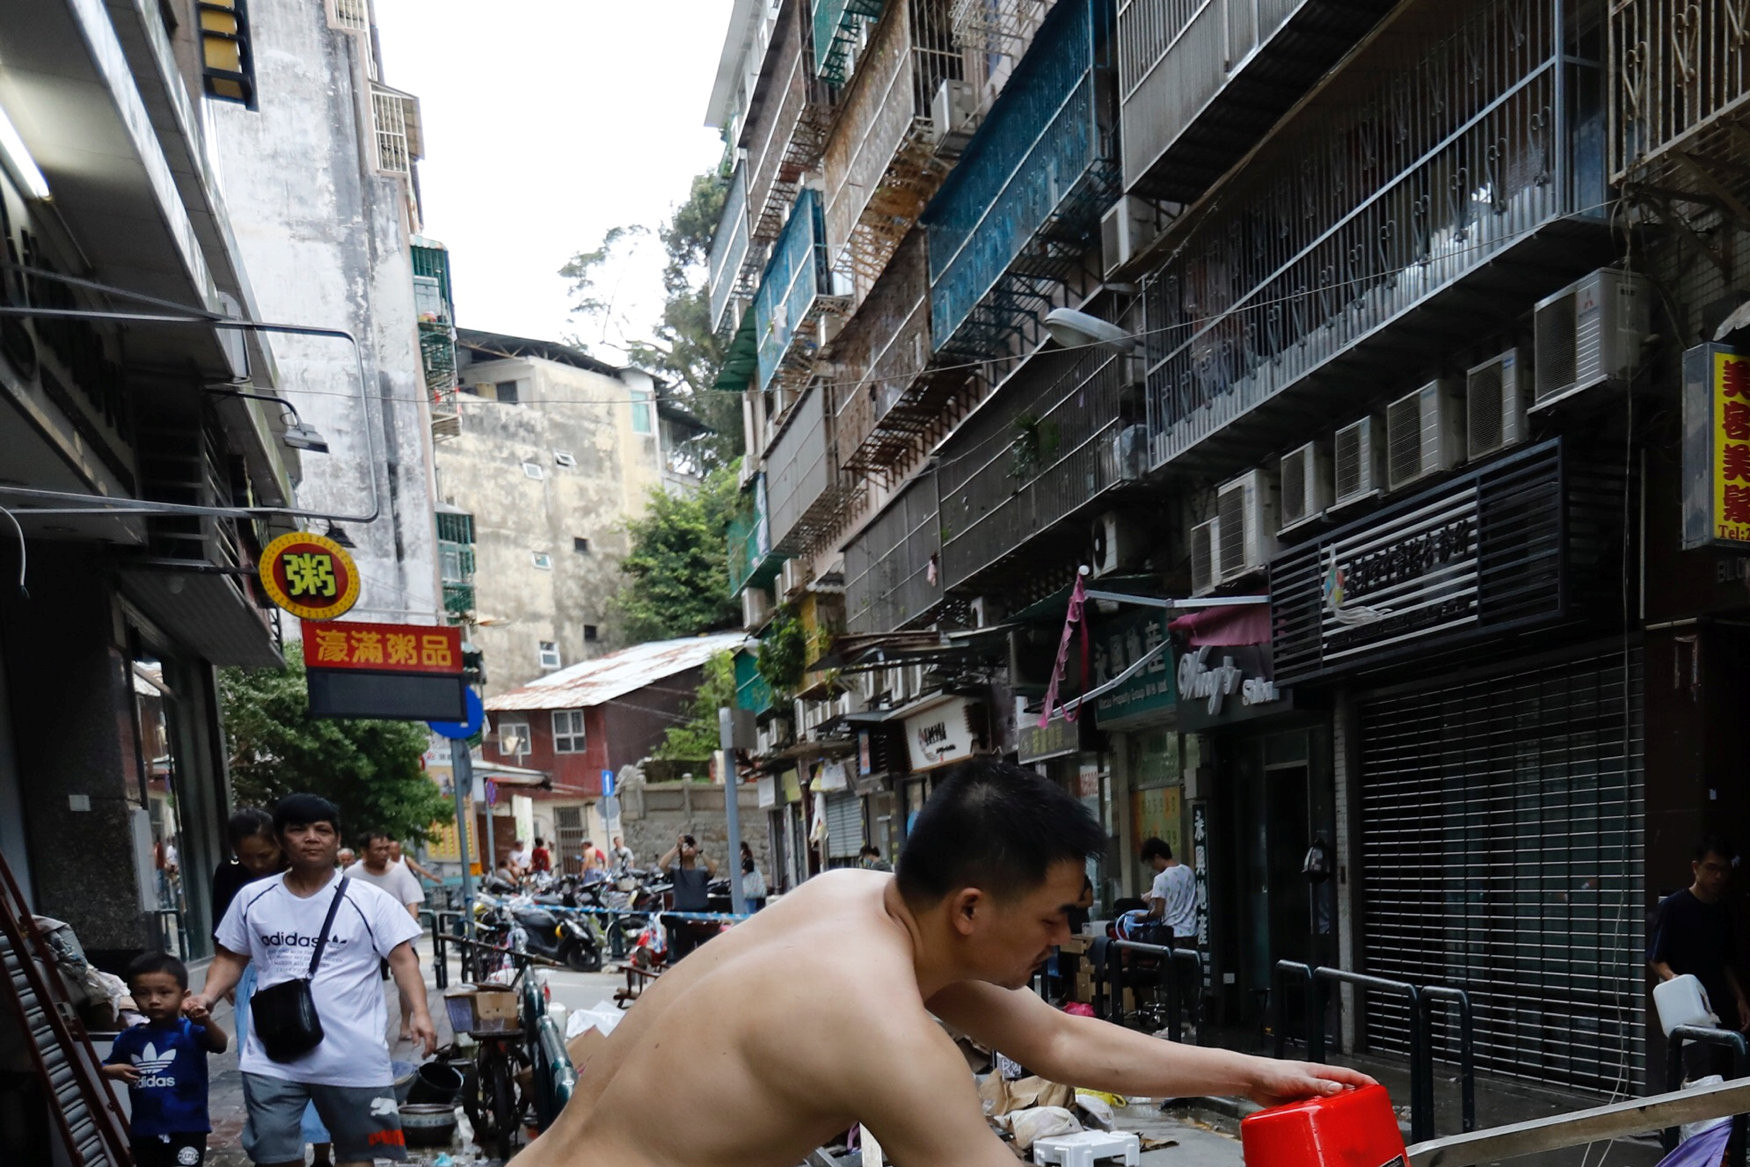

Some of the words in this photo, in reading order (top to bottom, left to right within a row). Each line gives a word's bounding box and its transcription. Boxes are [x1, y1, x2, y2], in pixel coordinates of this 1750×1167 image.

[283, 553, 337, 598] 粥
[315, 629, 453, 668] 濠滿粥品
[261, 931, 320, 948] adidas
[136, 1075, 175, 1088] didas
